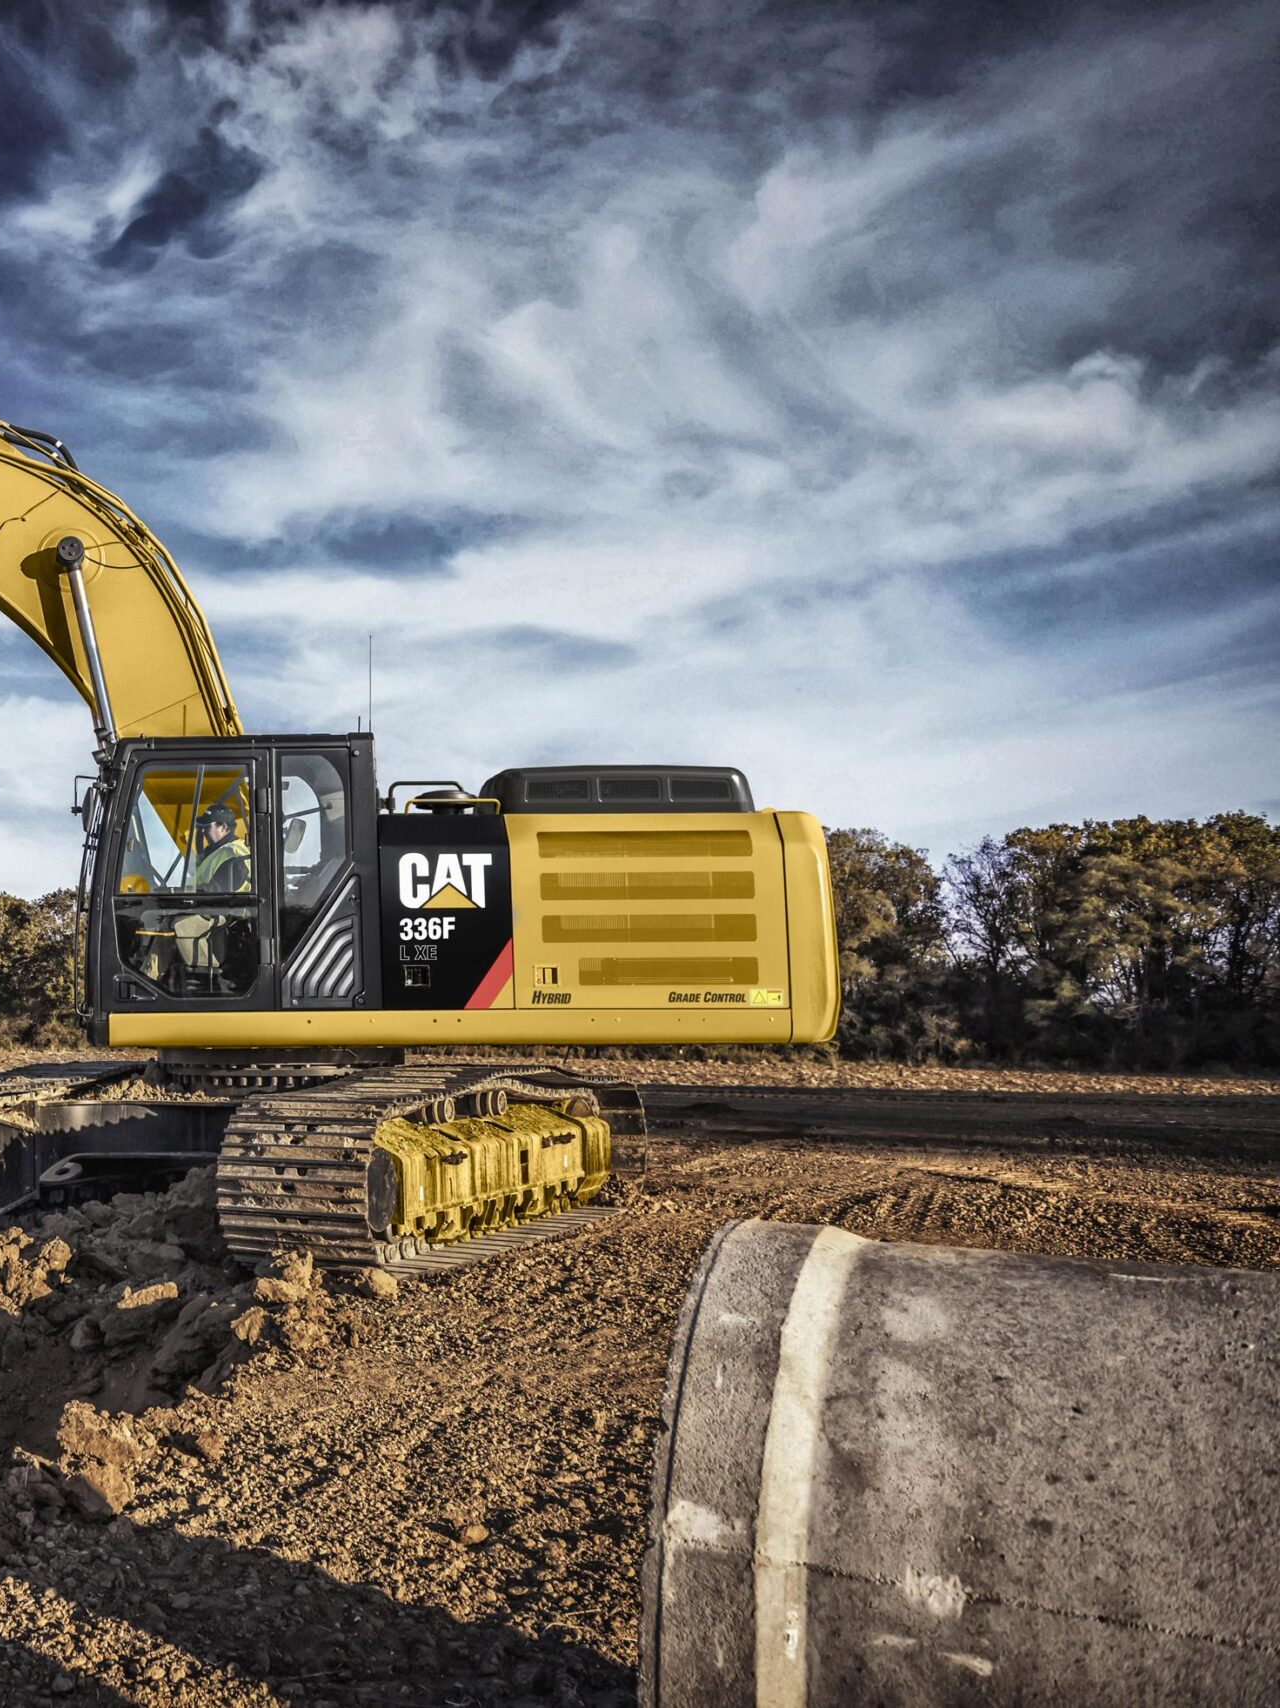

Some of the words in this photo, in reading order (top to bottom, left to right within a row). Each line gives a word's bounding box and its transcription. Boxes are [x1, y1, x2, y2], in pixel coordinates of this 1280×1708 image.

[398, 853, 493, 909] CAT
[399, 917, 456, 941] 336F
[399, 945, 410, 961] L
[414, 945, 438, 961] XE
